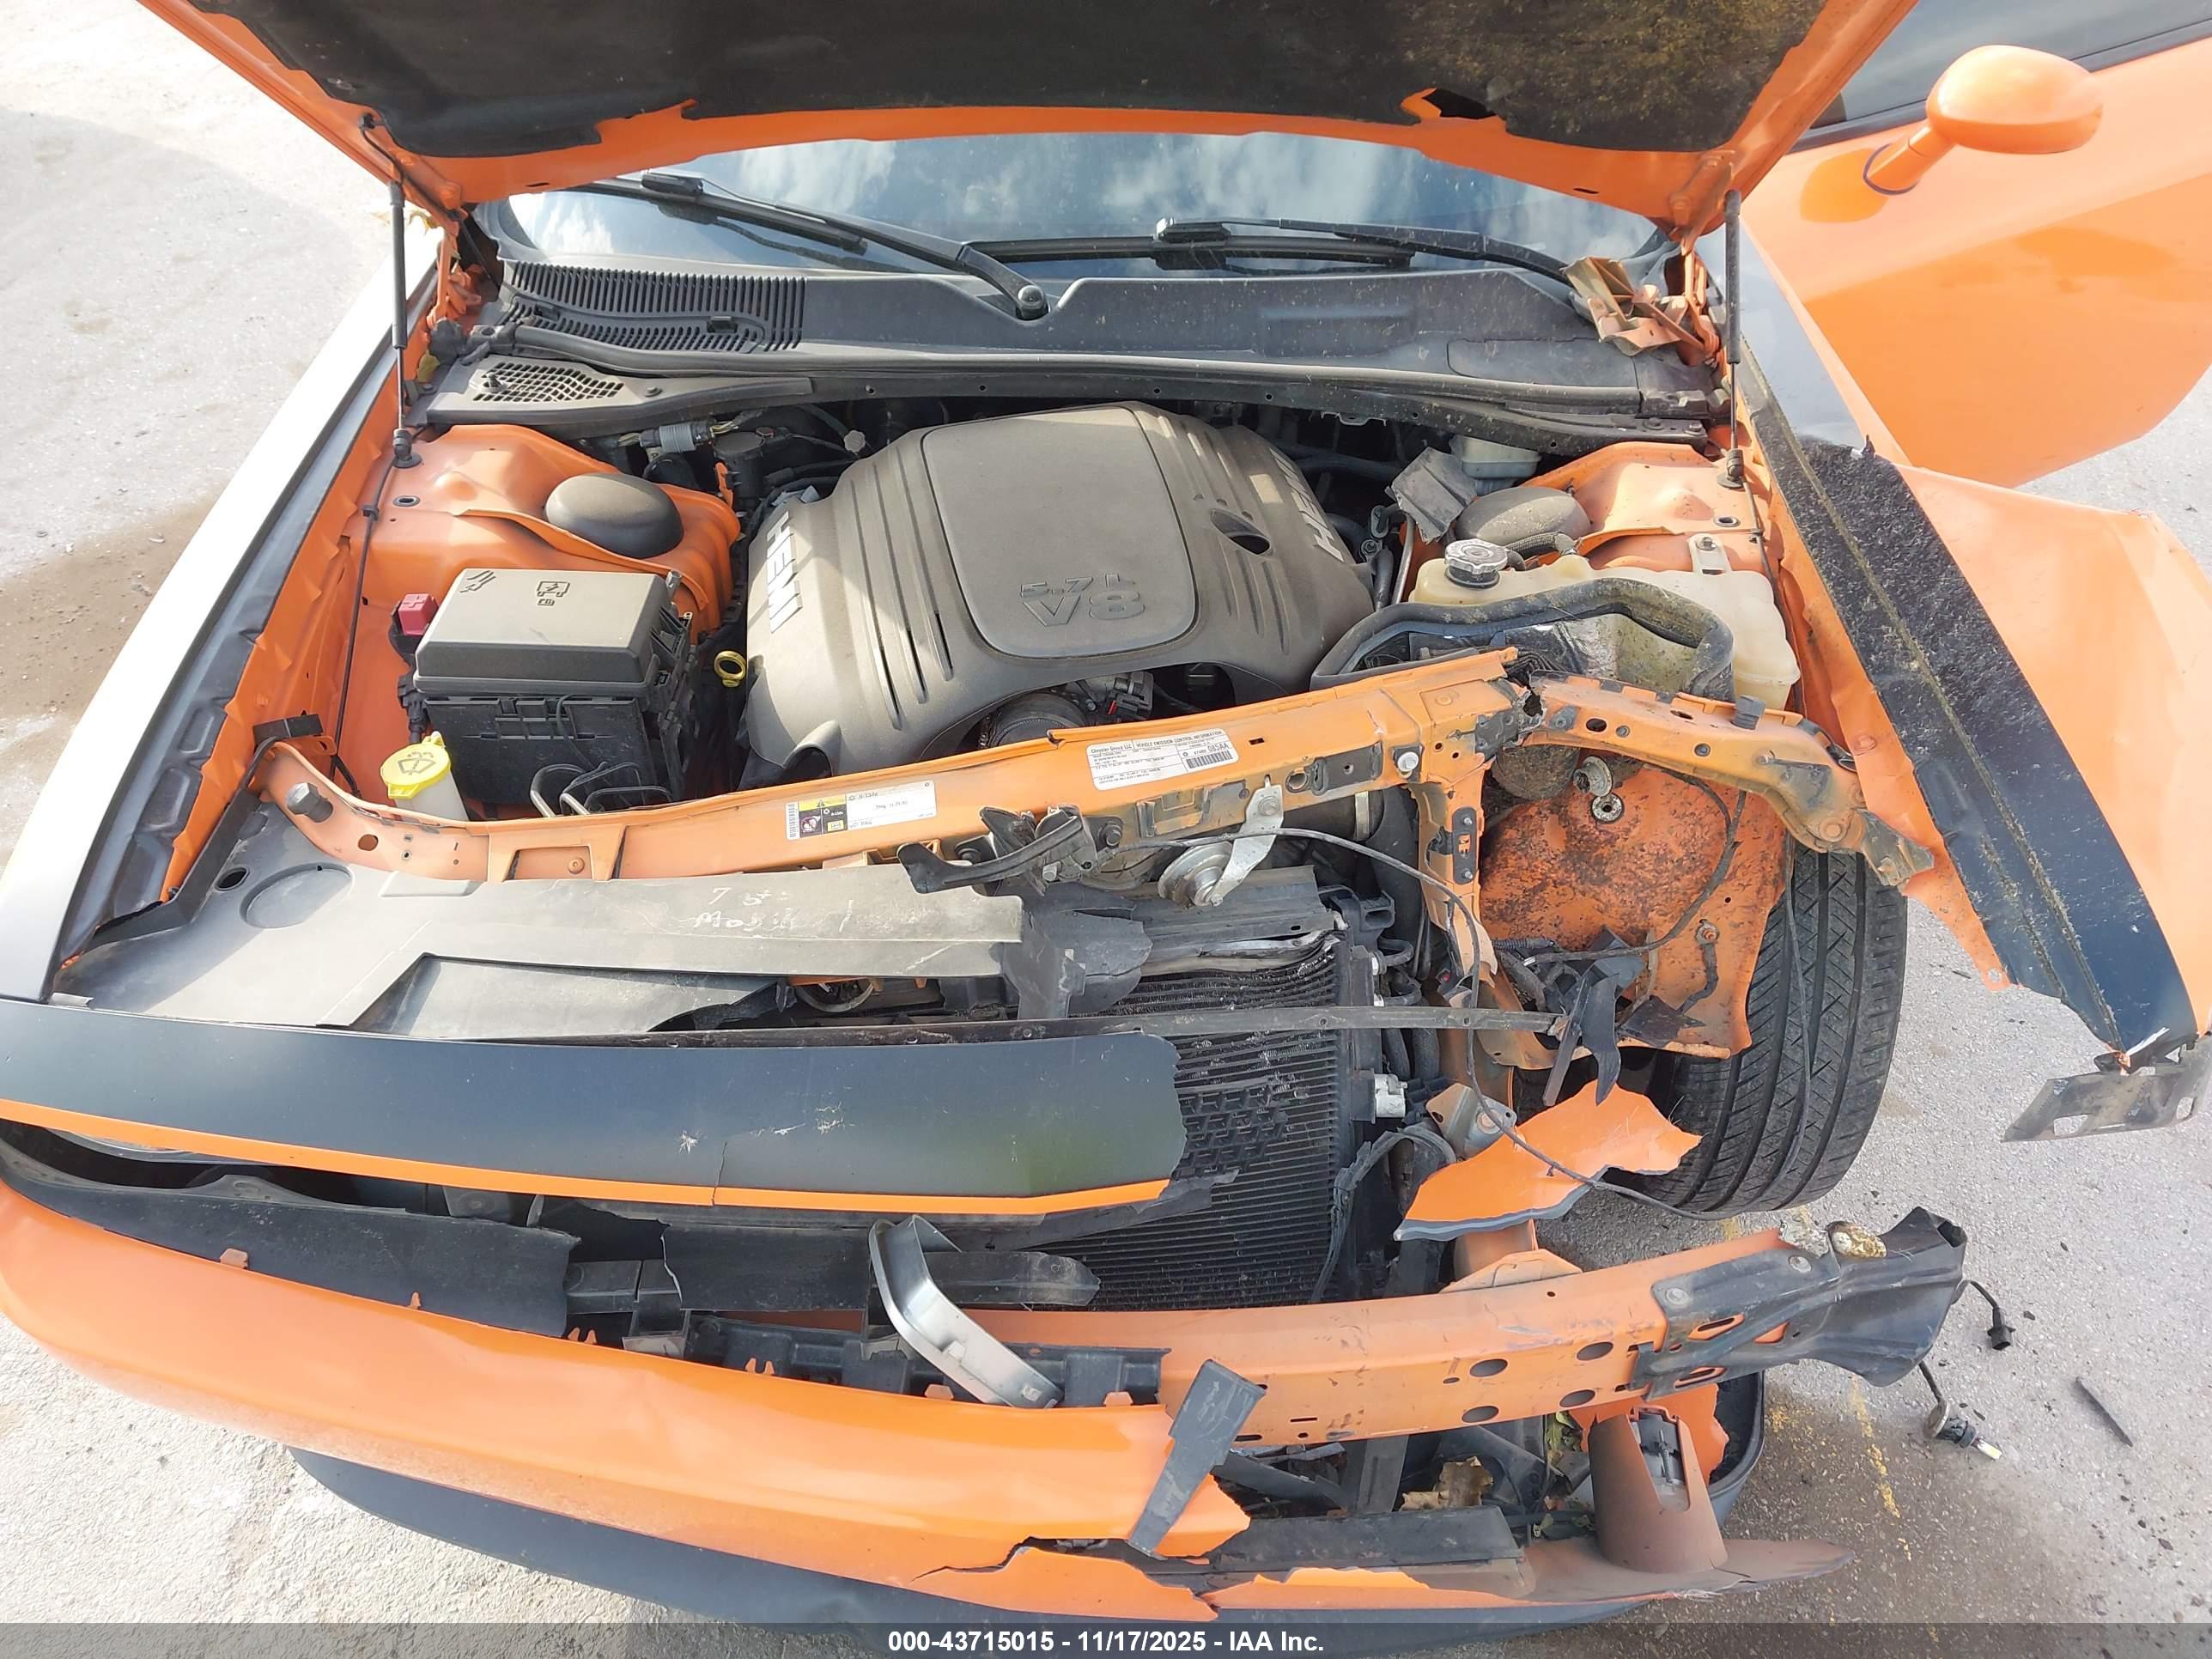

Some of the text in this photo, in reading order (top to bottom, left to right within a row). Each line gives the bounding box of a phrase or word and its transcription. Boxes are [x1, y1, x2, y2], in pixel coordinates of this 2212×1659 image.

[1269, 447, 1344, 562] HEMI
[766, 511, 802, 634] HEMI
[1020, 576, 1095, 599] 5.7
[1022, 590, 1146, 628] V8
[1194, 731, 1223, 739] INFORMATION
